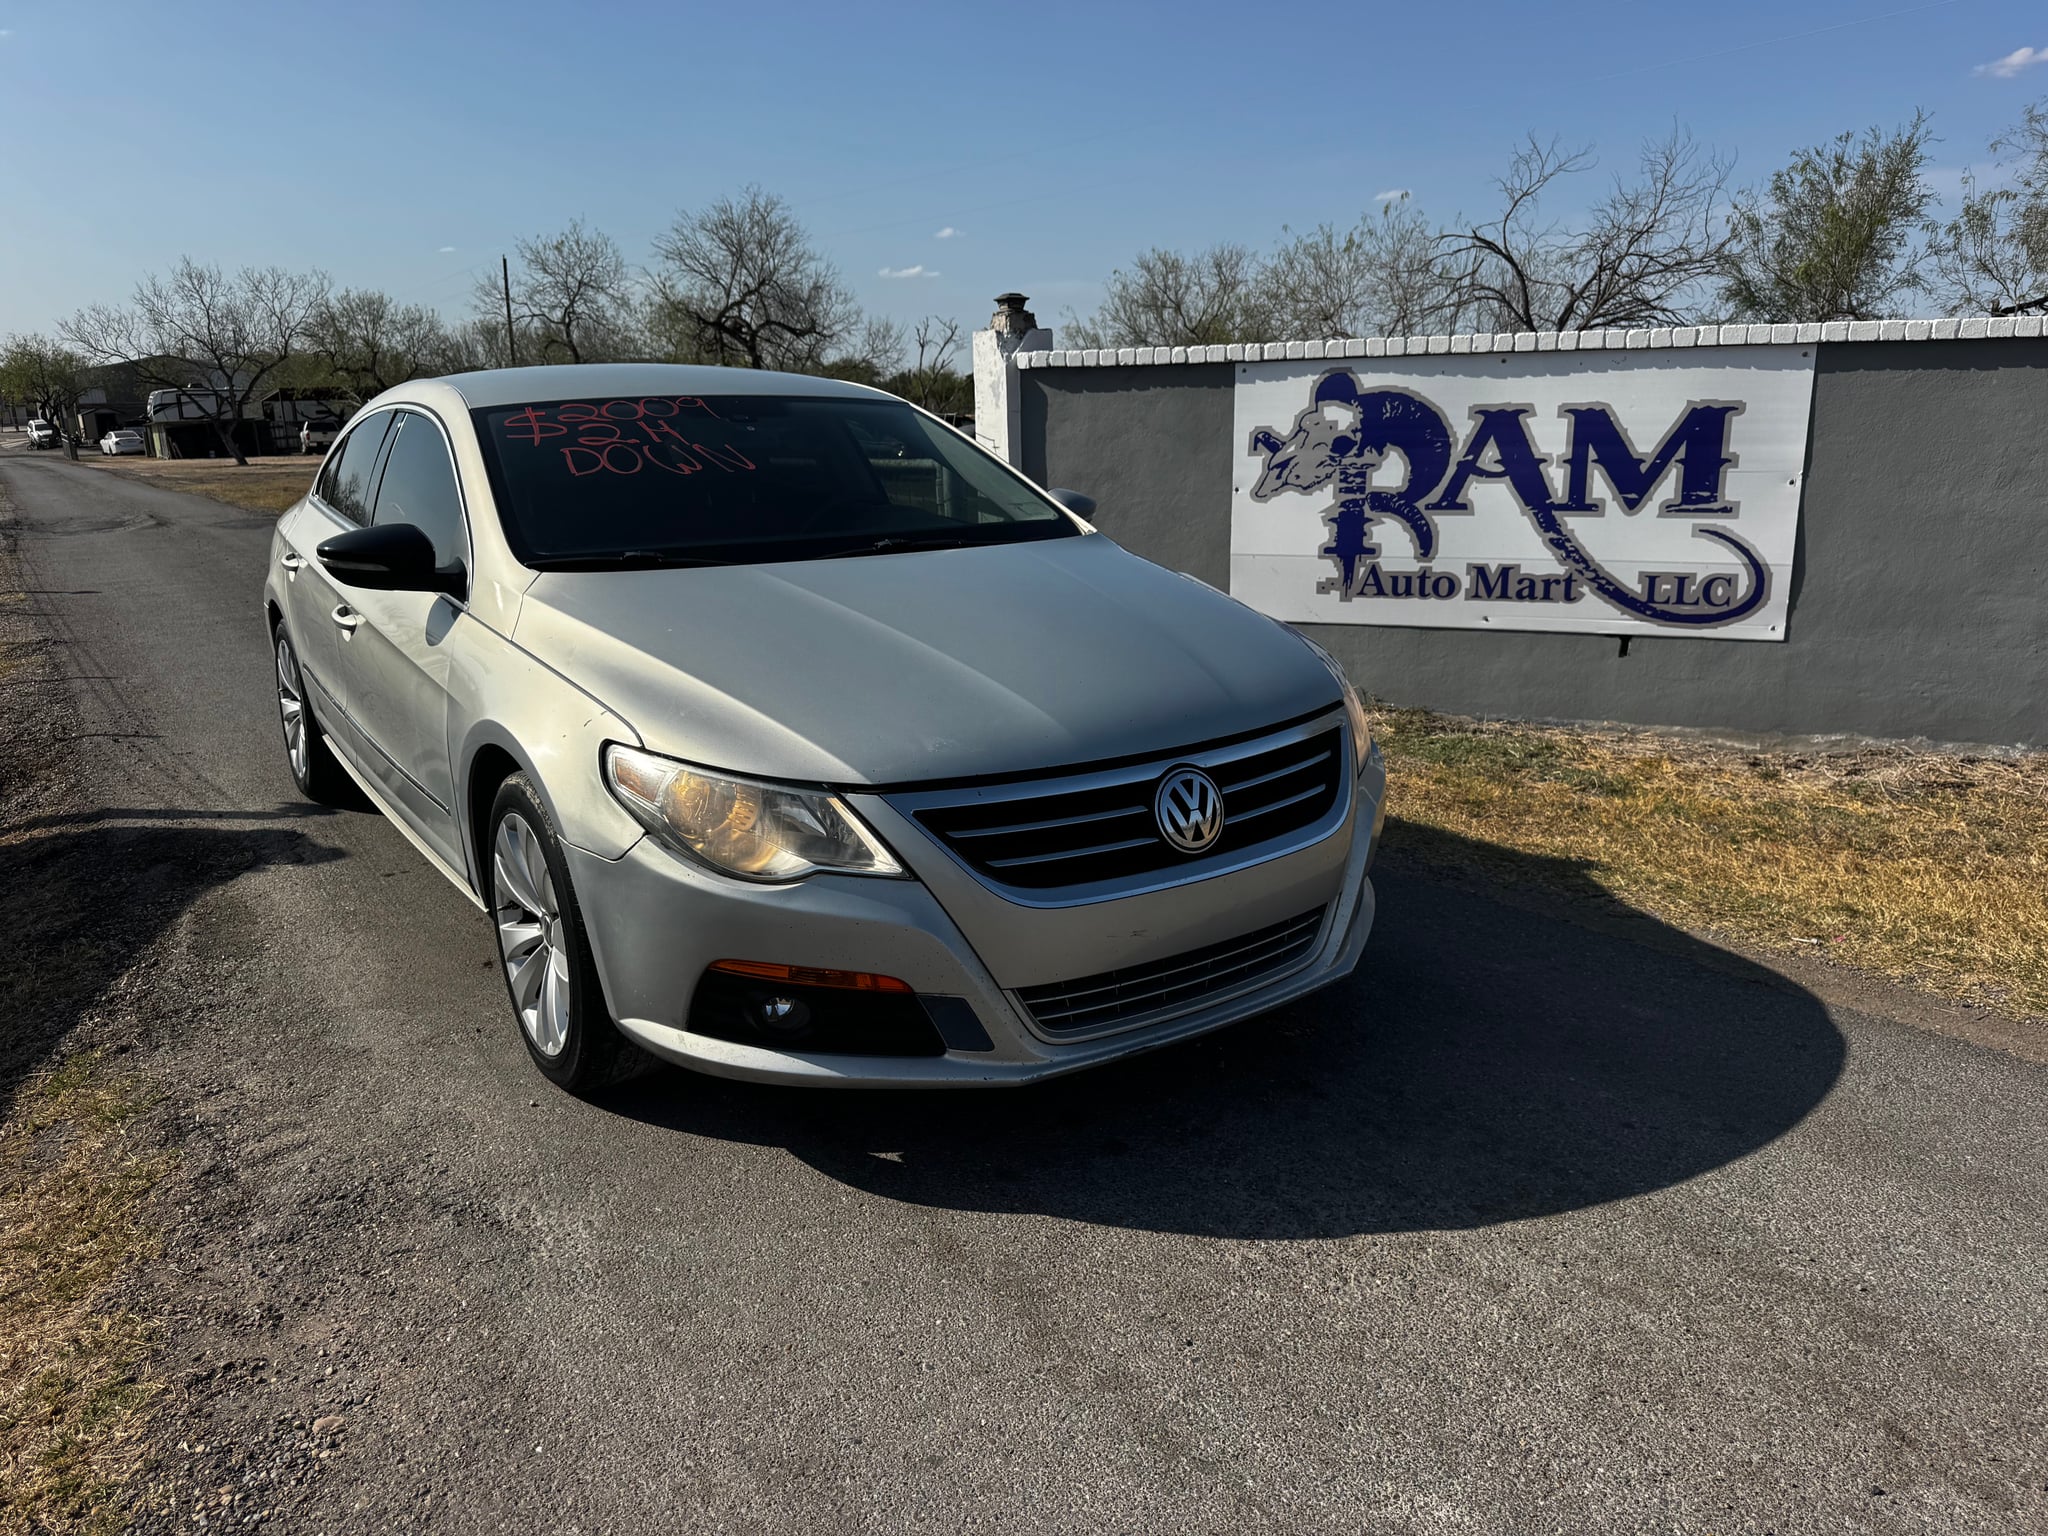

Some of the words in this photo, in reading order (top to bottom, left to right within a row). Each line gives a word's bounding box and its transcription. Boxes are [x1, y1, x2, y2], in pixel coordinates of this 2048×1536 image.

[560, 443, 756, 476] DOWN
[1357, 563, 1456, 599] Auto
[1472, 566, 1578, 601] Mart
[1644, 574, 1733, 608] LLC
[1158, 770, 1221, 850] VW
